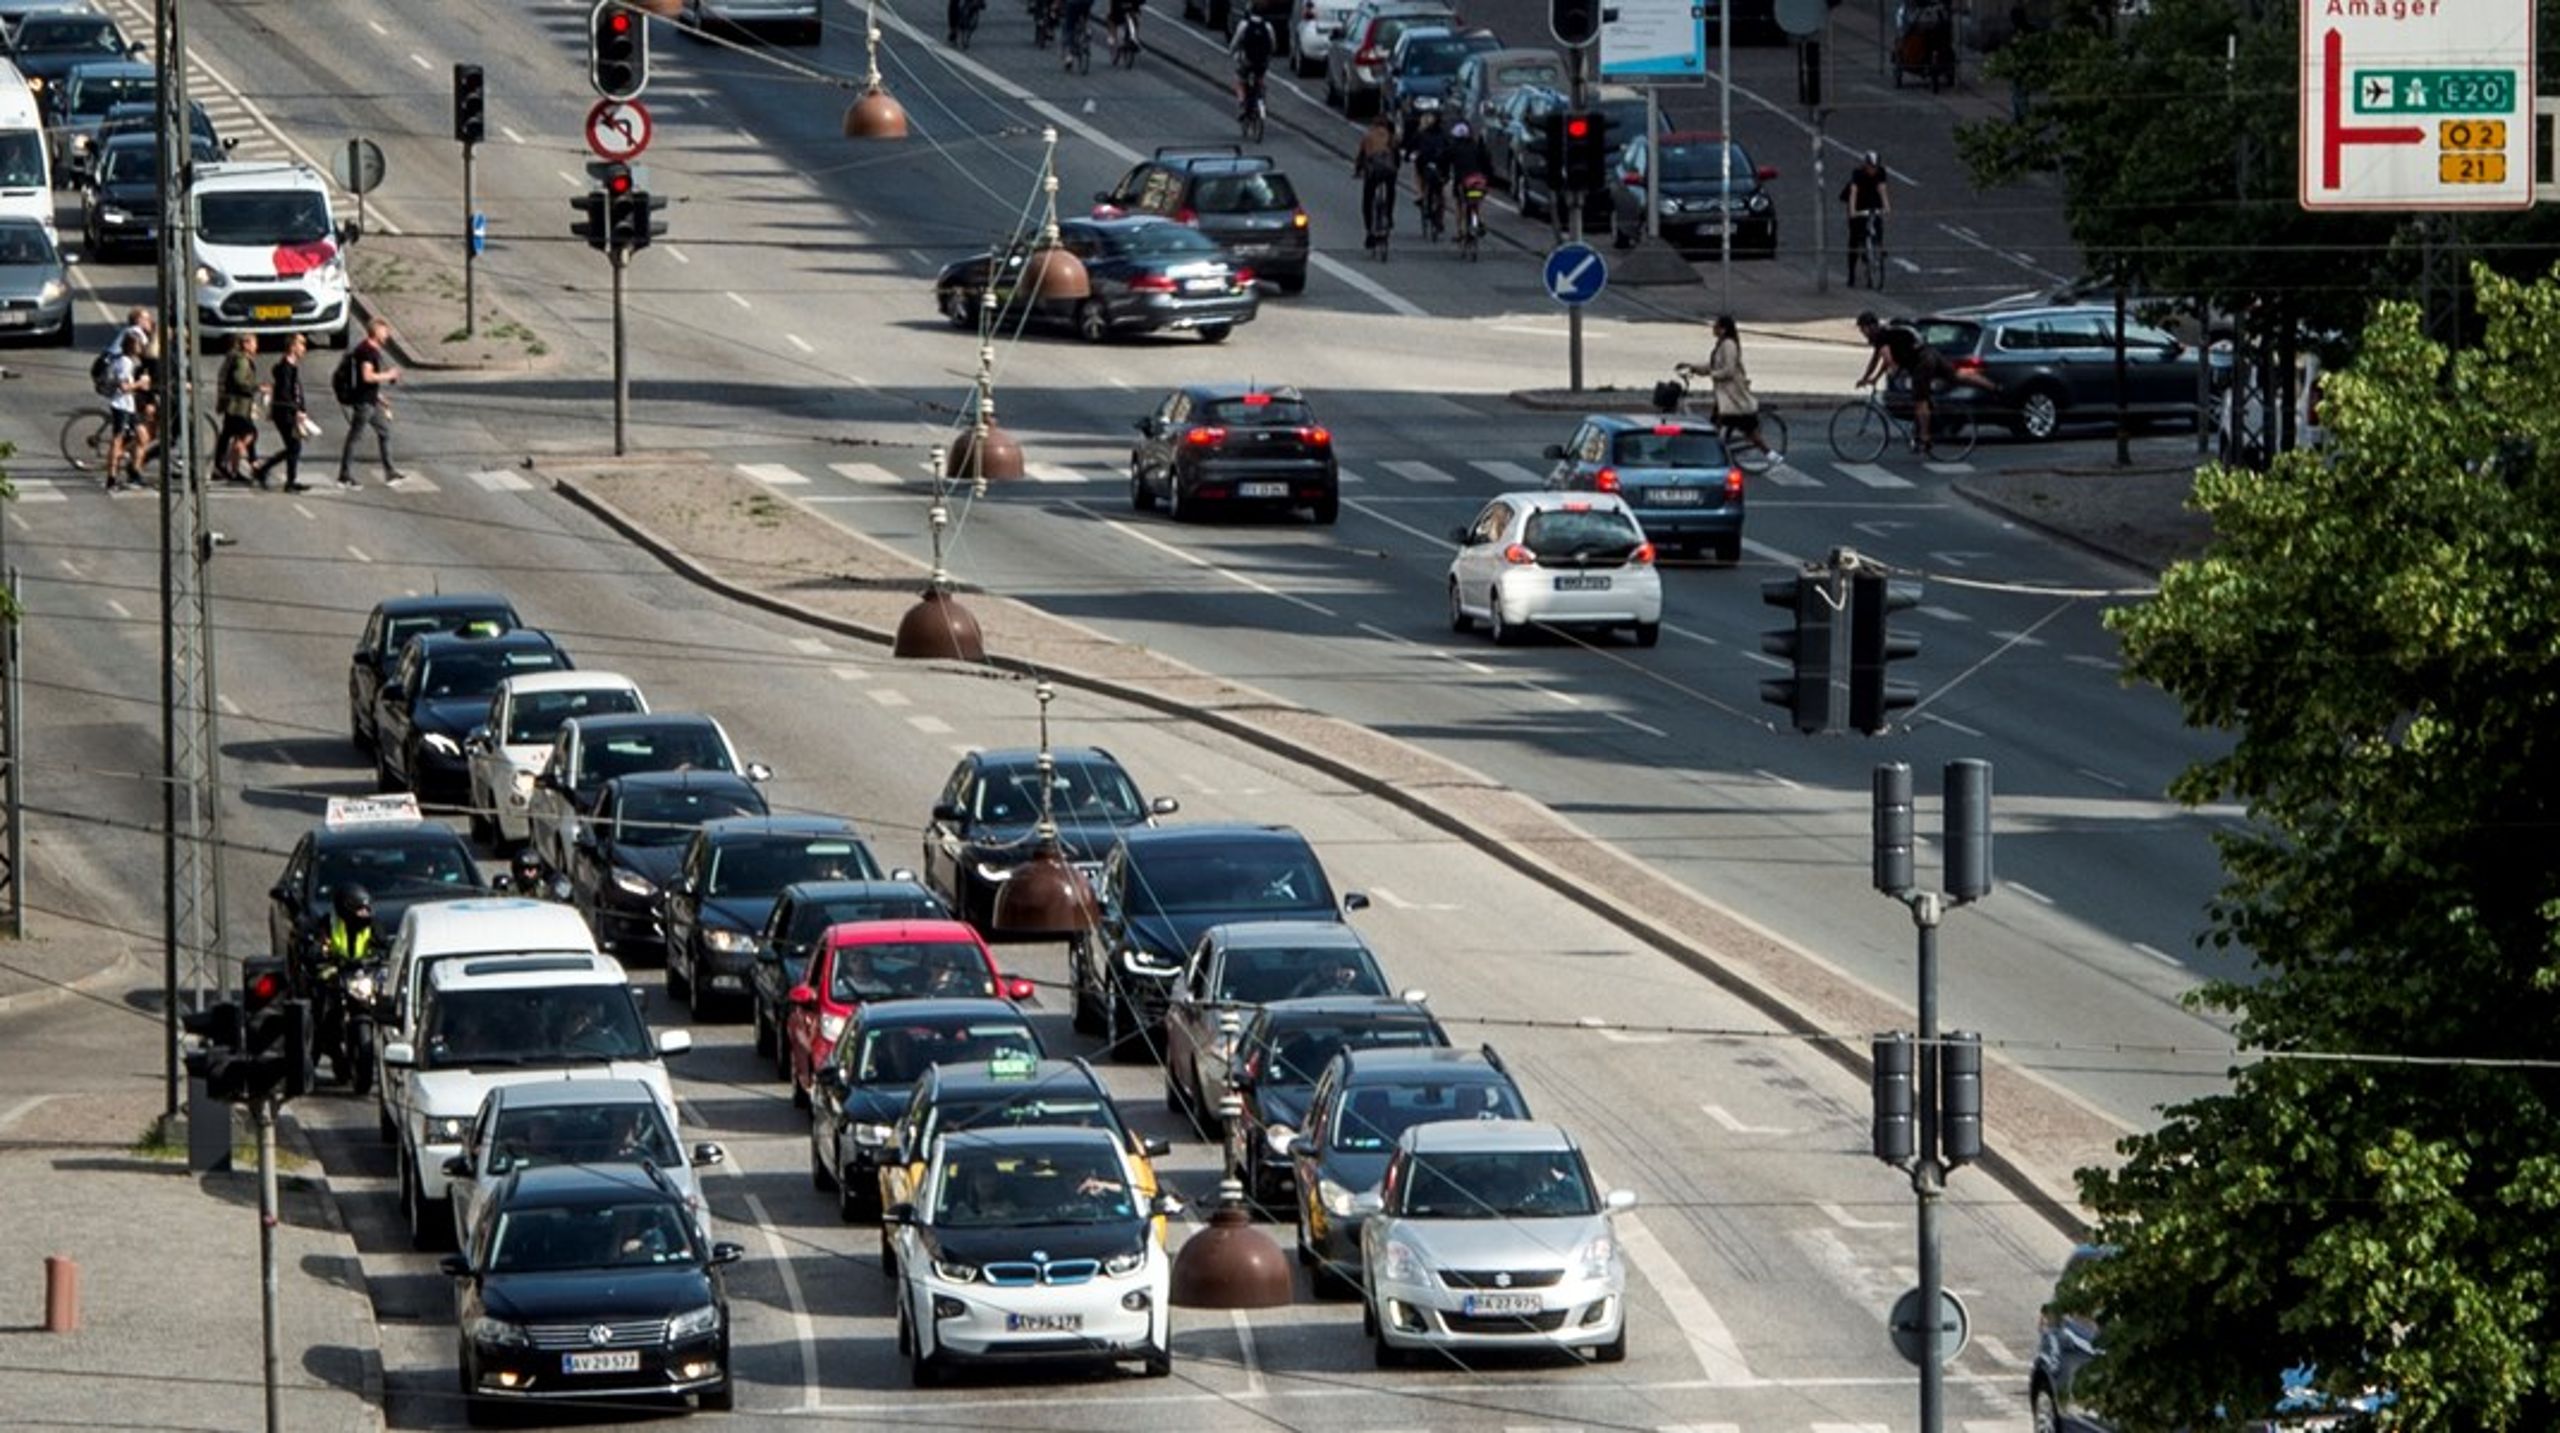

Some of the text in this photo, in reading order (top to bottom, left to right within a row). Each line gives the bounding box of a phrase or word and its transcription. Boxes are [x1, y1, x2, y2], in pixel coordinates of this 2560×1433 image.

[2327, 0, 2440, 20] Amager
[2447, 82, 2499, 102] E20
[2460, 160, 2485, 178] 21
